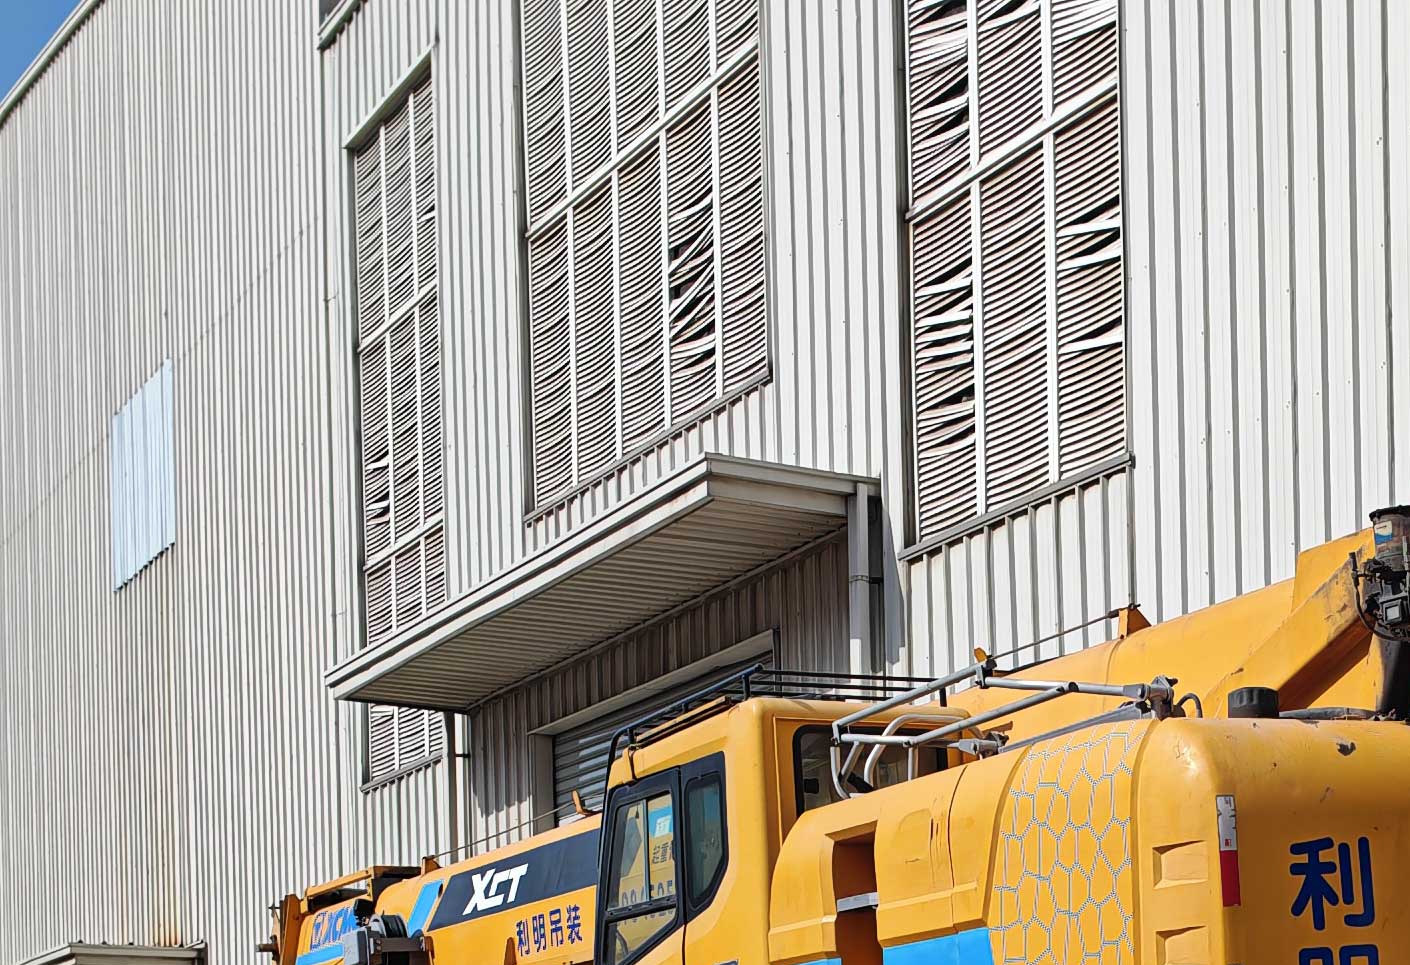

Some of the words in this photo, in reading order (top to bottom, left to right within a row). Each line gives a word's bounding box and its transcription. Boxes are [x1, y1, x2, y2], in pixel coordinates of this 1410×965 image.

[462, 863, 529, 916] XCT
[515, 903, 583, 957] 利明吊装
